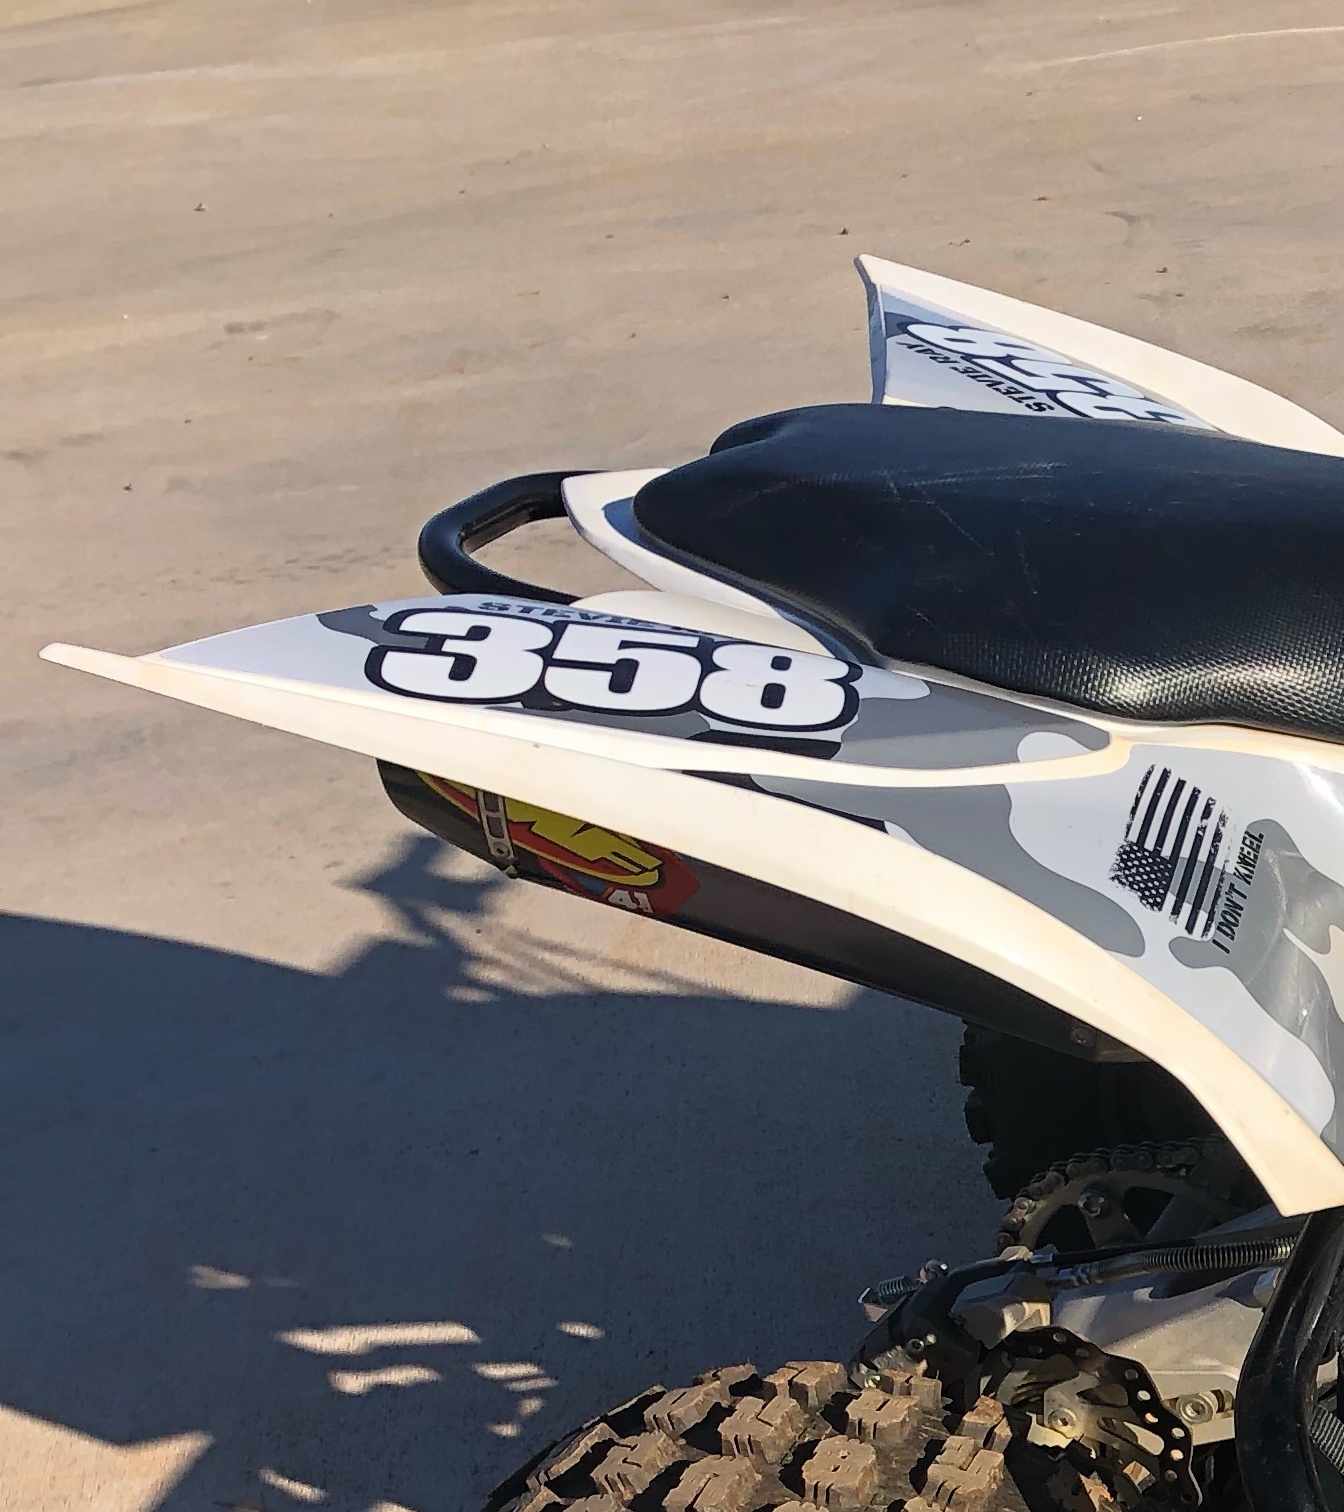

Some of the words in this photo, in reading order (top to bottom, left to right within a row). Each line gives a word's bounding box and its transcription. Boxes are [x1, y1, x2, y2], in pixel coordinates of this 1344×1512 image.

[896, 341, 952, 364] RAY
[953, 366, 1055, 413] STEVIE
[367, 608, 861, 731] 358
[1232, 830, 1265, 886] KNEEL
[1216, 882, 1249, 942] DON'T
[1211, 938, 1231, 955] I
